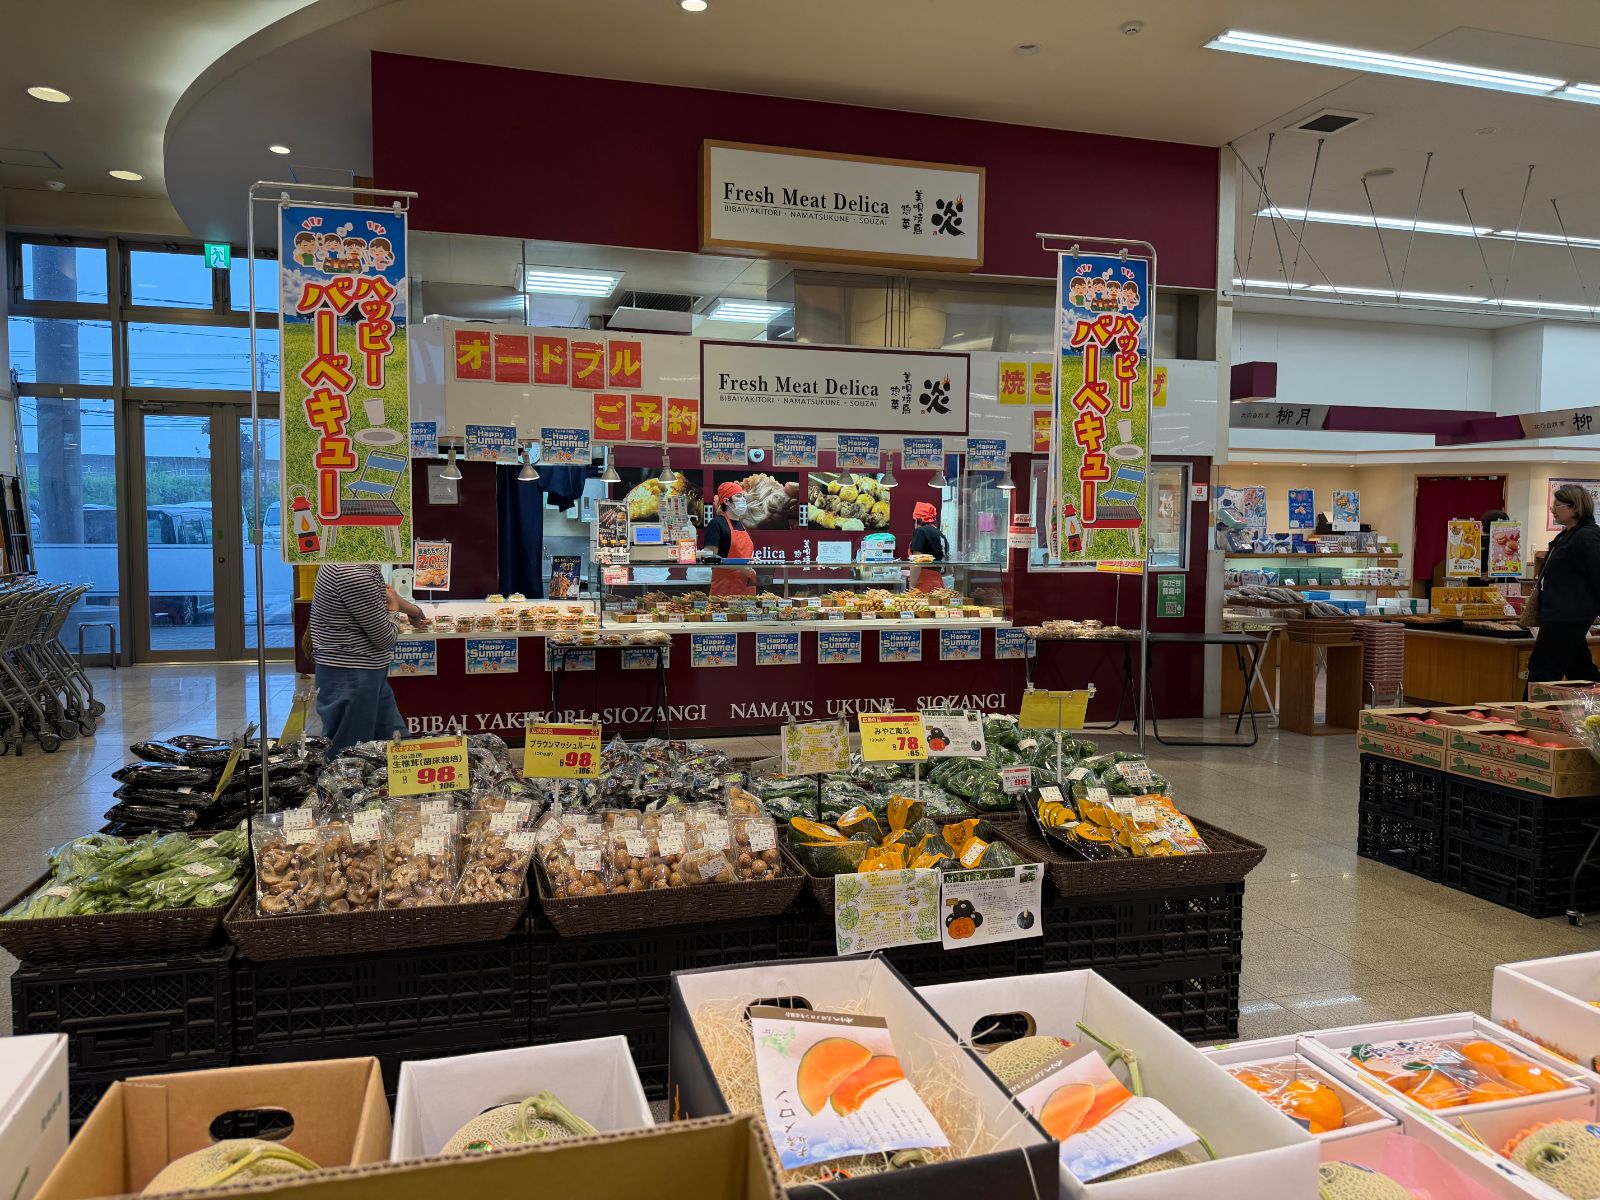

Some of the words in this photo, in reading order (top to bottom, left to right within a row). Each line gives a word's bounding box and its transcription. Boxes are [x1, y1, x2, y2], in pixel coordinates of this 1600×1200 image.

[723, 182, 775, 204] Fresh
[782, 187, 827, 210] Meat
[833, 192, 890, 214] Delica
[724, 204, 781, 217] BIBAIYAKITORI
[790, 211, 850, 223] NAMATSUKUNE
[859, 216, 888, 226] SOUZAI
[354, 276, 395, 389] ハッピー
[457, 339, 641, 379] オードブル
[1113, 314, 1141, 412] ハッピー
[719, 373, 769, 392] Fresh
[776, 376, 819, 395] Meat
[825, 378, 879, 397] Delica
[297, 277, 358, 519] バーベキュー
[719, 394, 775, 404] BIBAIYAKITORI
[783, 397, 840, 407] NAMATSUKUNE
[850, 400, 878, 408] SOUZAI
[595, 401, 698, 436] ご予約
[1070, 314, 1113, 524] バーベキュー
[1277, 407, 1312, 426] 柳月
[1572, 412, 1593, 431] 柳
[477, 430, 505, 438] Happy
[552, 433, 578, 441] Happy
[712, 435, 735, 443] Happy
[468, 435, 515, 446] Summer
[544, 438, 588, 448] Summer
[705, 441, 744, 449] Summer
[847, 439, 870, 447] Happy
[776, 444, 815, 452] Summer
[840, 445, 878, 453] Summer
[969, 448, 1004, 456] Summer
[752, 546, 785, 560] elica
[703, 638, 726, 646] Happy
[767, 637, 789, 645] Happy
[822, 641, 859, 649] Summer
[883, 640, 920, 648] Summer
[943, 639, 979, 647] Summer
[395, 645, 423, 653] Happy
[695, 644, 735, 652] Summer
[394, 652, 434, 660] ummer
[470, 649, 515, 658] Summer
[730, 700, 813, 720] NAMATS
[826, 698, 895, 716] UKUNE
[407, 714, 468, 734] BIBAI
[602, 704, 707, 725] SIOZANGI
[874, 727, 911, 735] みやこ南瓜
[529, 739, 597, 749] ブラウンマッシュルーム
[896, 736, 919, 750] 78
[565, 751, 592, 767] 98
[417, 765, 456, 784] 98
[578, 767, 591, 775] 106
[439, 781, 455, 789] 106
